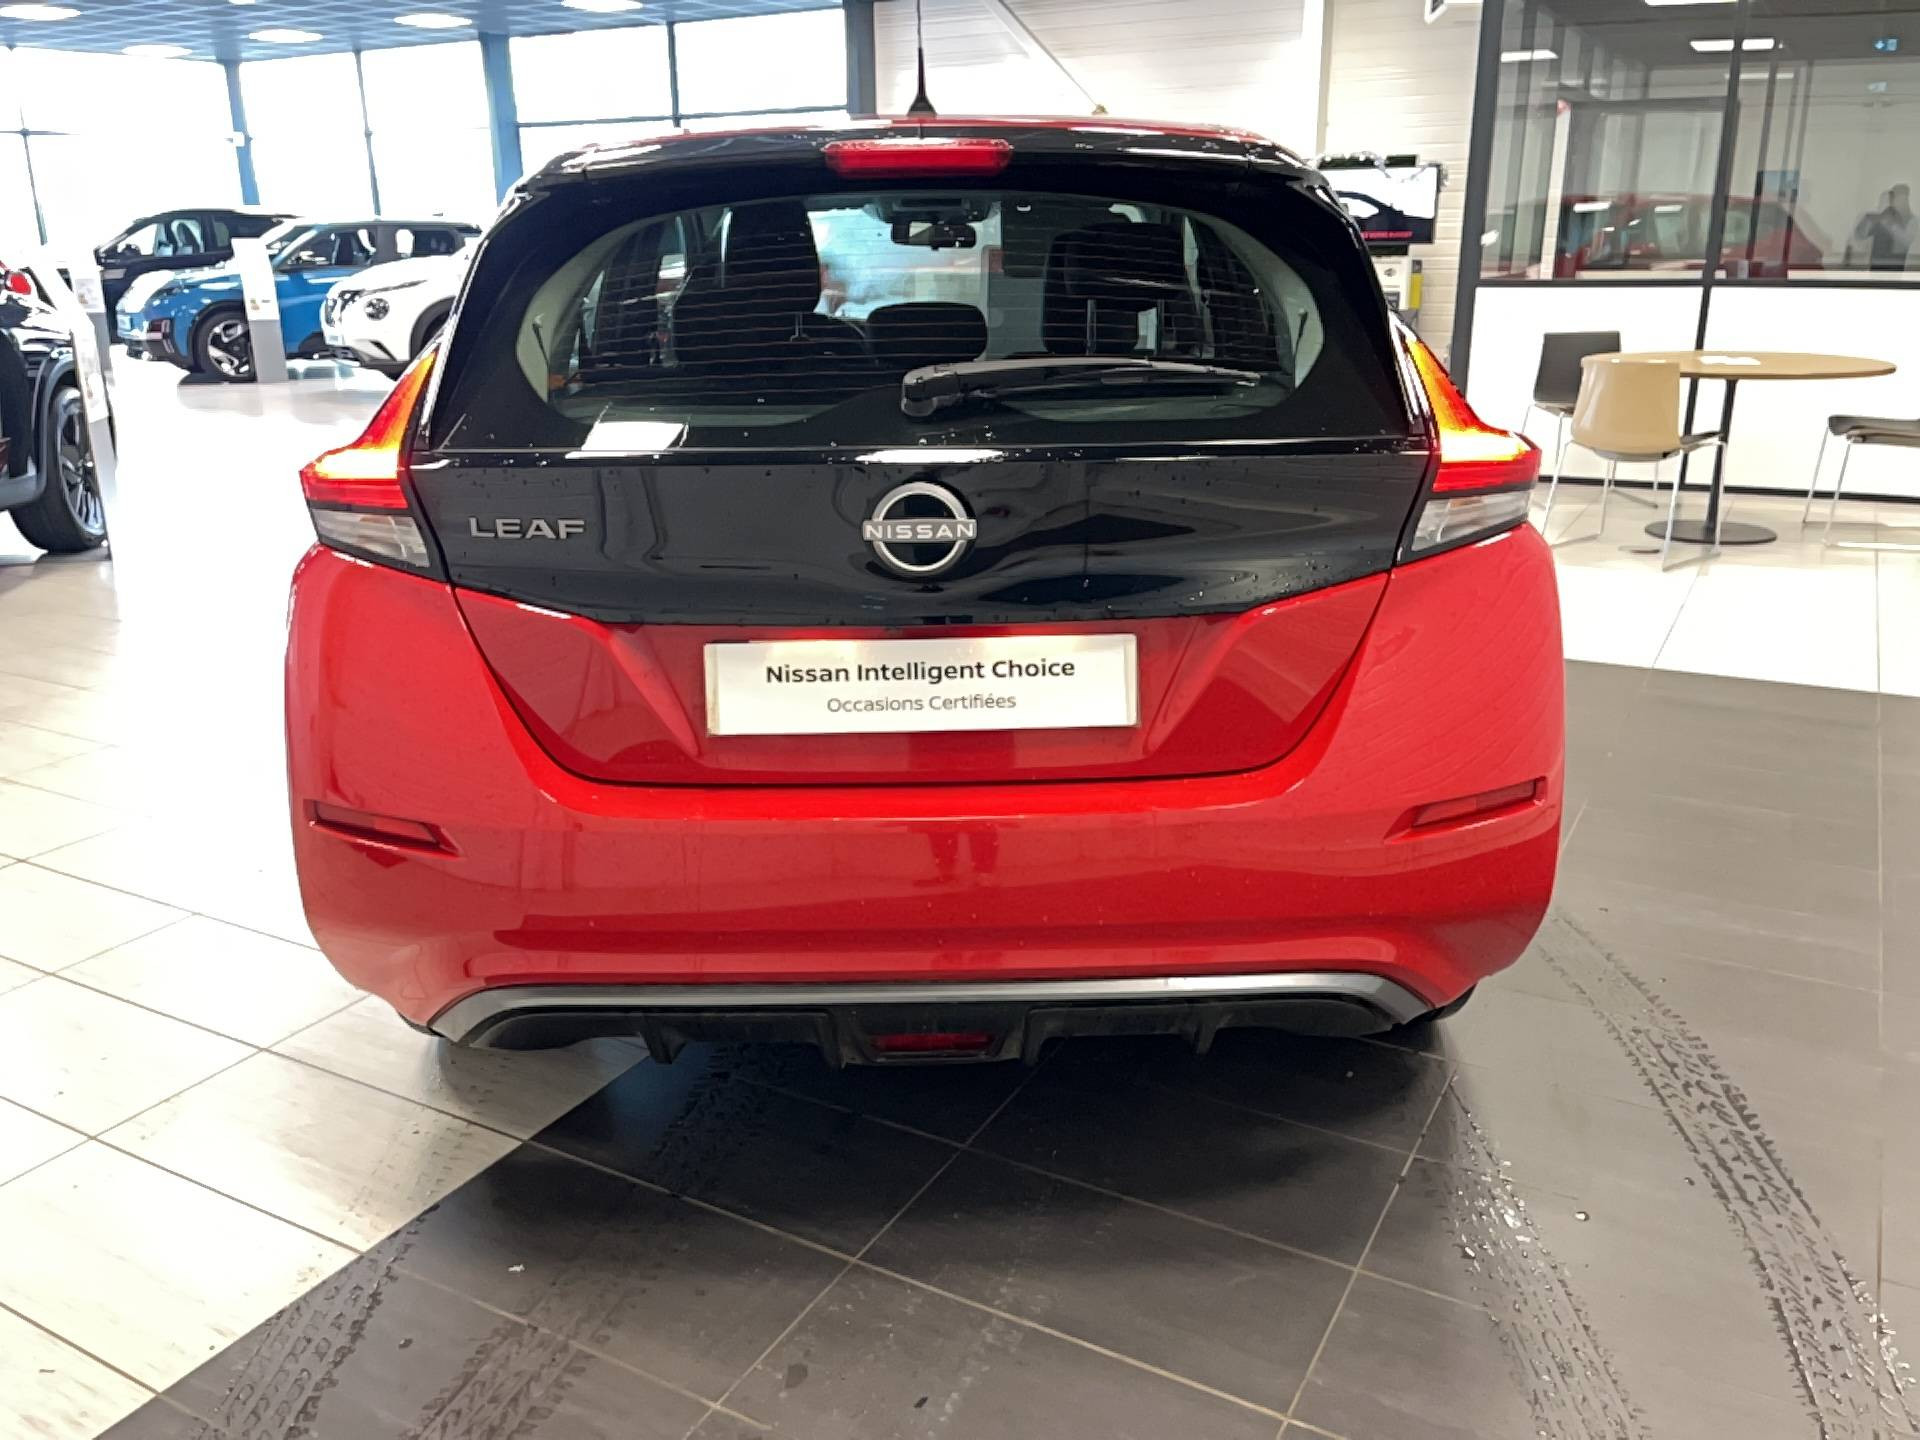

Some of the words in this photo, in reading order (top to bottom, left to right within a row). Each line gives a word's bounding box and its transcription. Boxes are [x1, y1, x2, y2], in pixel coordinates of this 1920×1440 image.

[469, 517, 585, 539] LEAF
[865, 523, 974, 539] NISSAN
[766, 665, 849, 683] Nissan
[857, 661, 985, 685] Intelligent
[992, 658, 1075, 679] Choice
[827, 696, 924, 713] Occasions
[929, 693, 1017, 711] Certifiées
